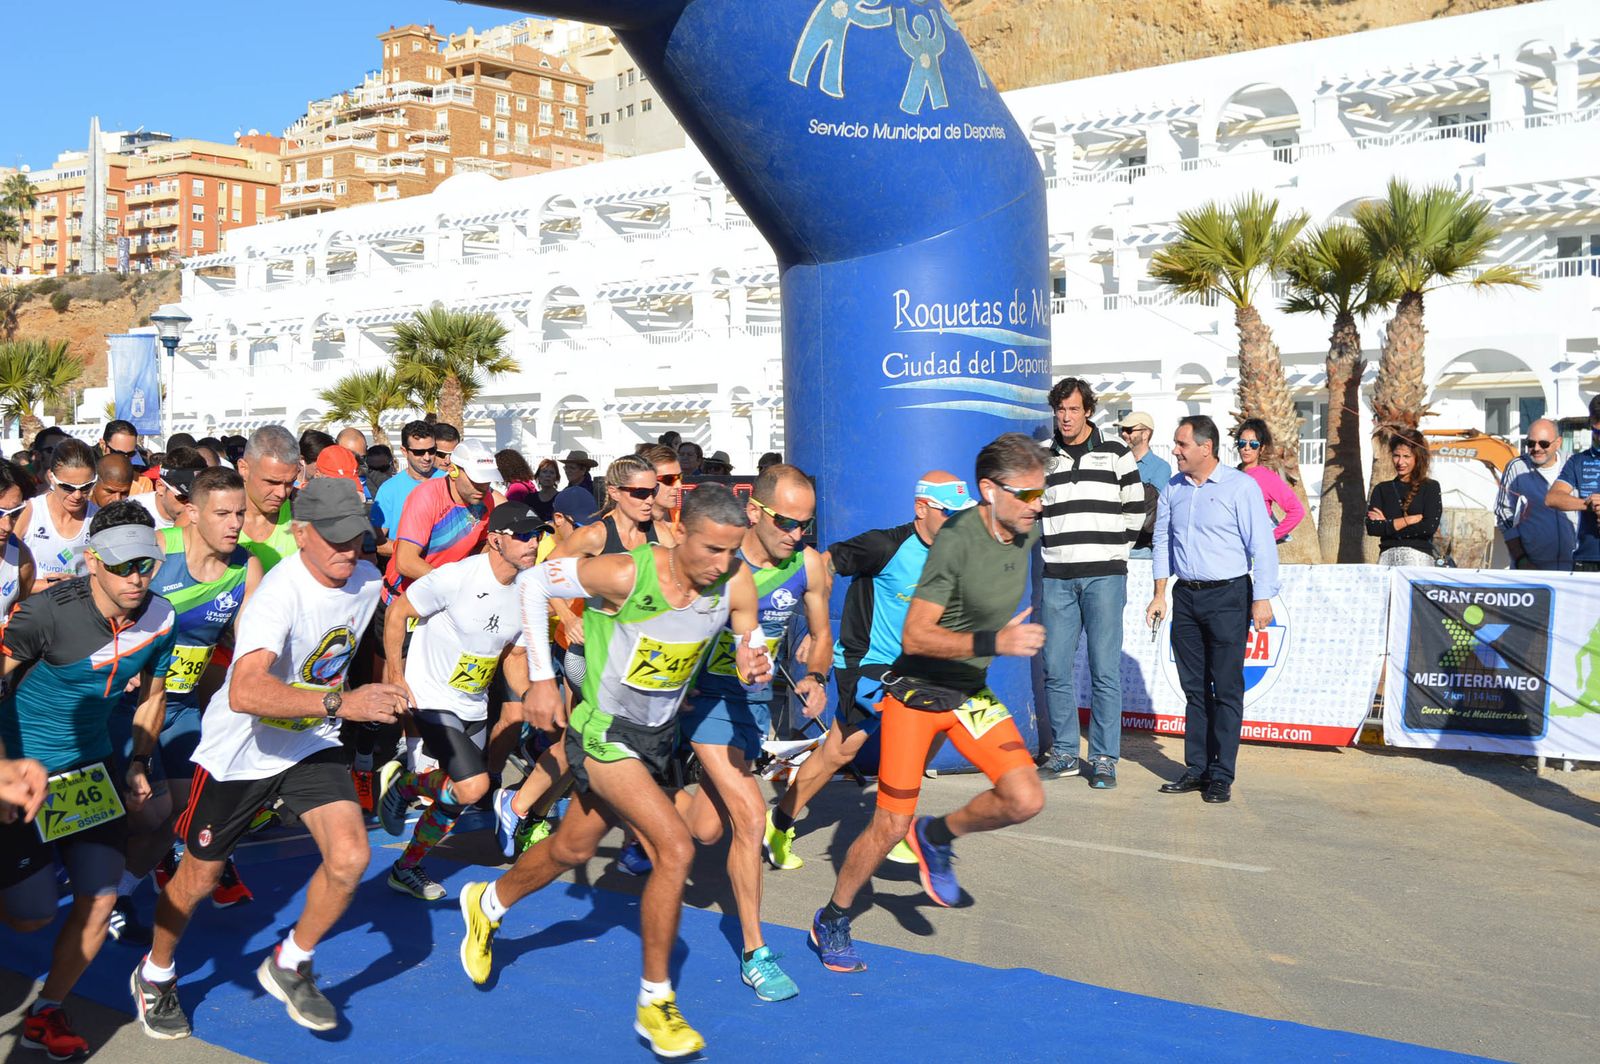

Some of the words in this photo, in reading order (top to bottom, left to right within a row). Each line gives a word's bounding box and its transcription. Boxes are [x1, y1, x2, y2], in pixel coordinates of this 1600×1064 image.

[808, 119, 869, 139] Servicio
[873, 123, 941, 143] Municipal
[944, 123, 961, 139] de
[964, 124, 1006, 142] Deportes
[893, 289, 1003, 334] Roquetas
[1008, 288, 1027, 325] de
[881, 351, 961, 378] Ciudad
[968, 350, 995, 375] del
[1439, 446, 1477, 457] CASE
[1426, 589, 1471, 604] GRAN
[1474, 592, 1535, 607] FONDO
[183, 661, 204, 675] 38
[1413, 672, 1540, 691] MEDITERRANEO
[1443, 691, 1450, 700] 7
[1451, 691, 1466, 700] km
[1421, 705, 1441, 715] Corre
[1462, 710, 1471, 718] el
[76, 785, 103, 807] 46
[77, 811, 108, 828] asisa
